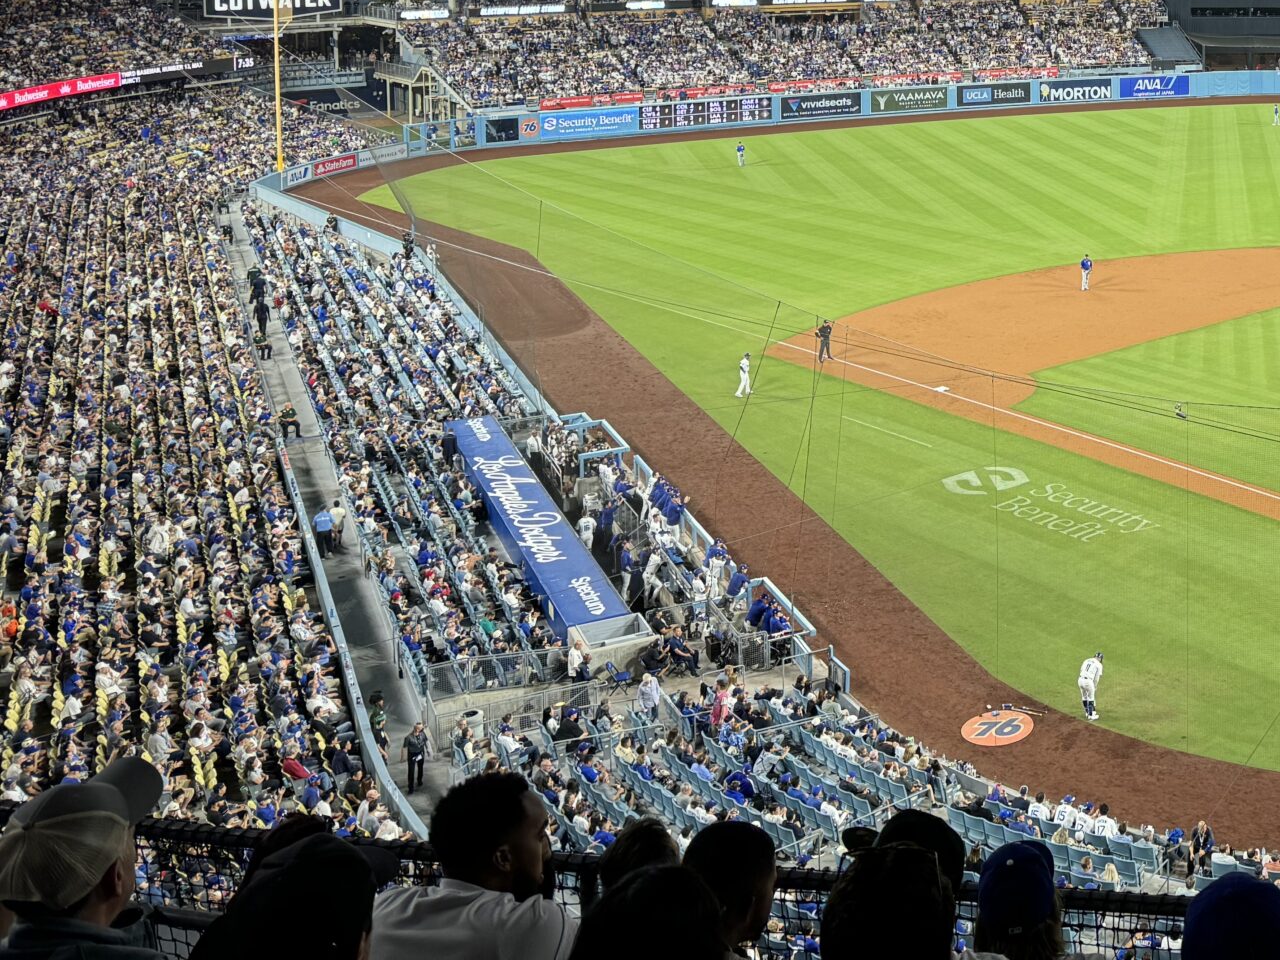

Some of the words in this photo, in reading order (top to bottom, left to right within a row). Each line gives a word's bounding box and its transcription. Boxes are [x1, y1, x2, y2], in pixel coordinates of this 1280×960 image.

[237, 58, 254, 68] 7:35
[122, 69, 135, 78] THIRD
[77, 77, 116, 91] Budweiser
[1133, 79, 1160, 90] ANA
[14, 88, 49, 104] Budweiser
[966, 91, 988, 99] UCLA
[994, 88, 1025, 99] Health
[1050, 85, 1111, 100] MORTON
[309, 100, 360, 111] Fanatics
[801, 98, 852, 109] vividseats
[521, 121, 537, 133] 76
[558, 118, 597, 128] Security
[600, 114, 632, 124] Benefit
[467, 417, 491, 441] Spectrum
[486, 473, 536, 522] Angeles
[1030, 482, 1160, 533] Security
[992, 495, 1108, 543] Benefit
[510, 511, 567, 564] Dodgers
[568, 576, 607, 615] Spectrum
[972, 717, 1025, 738] 76
